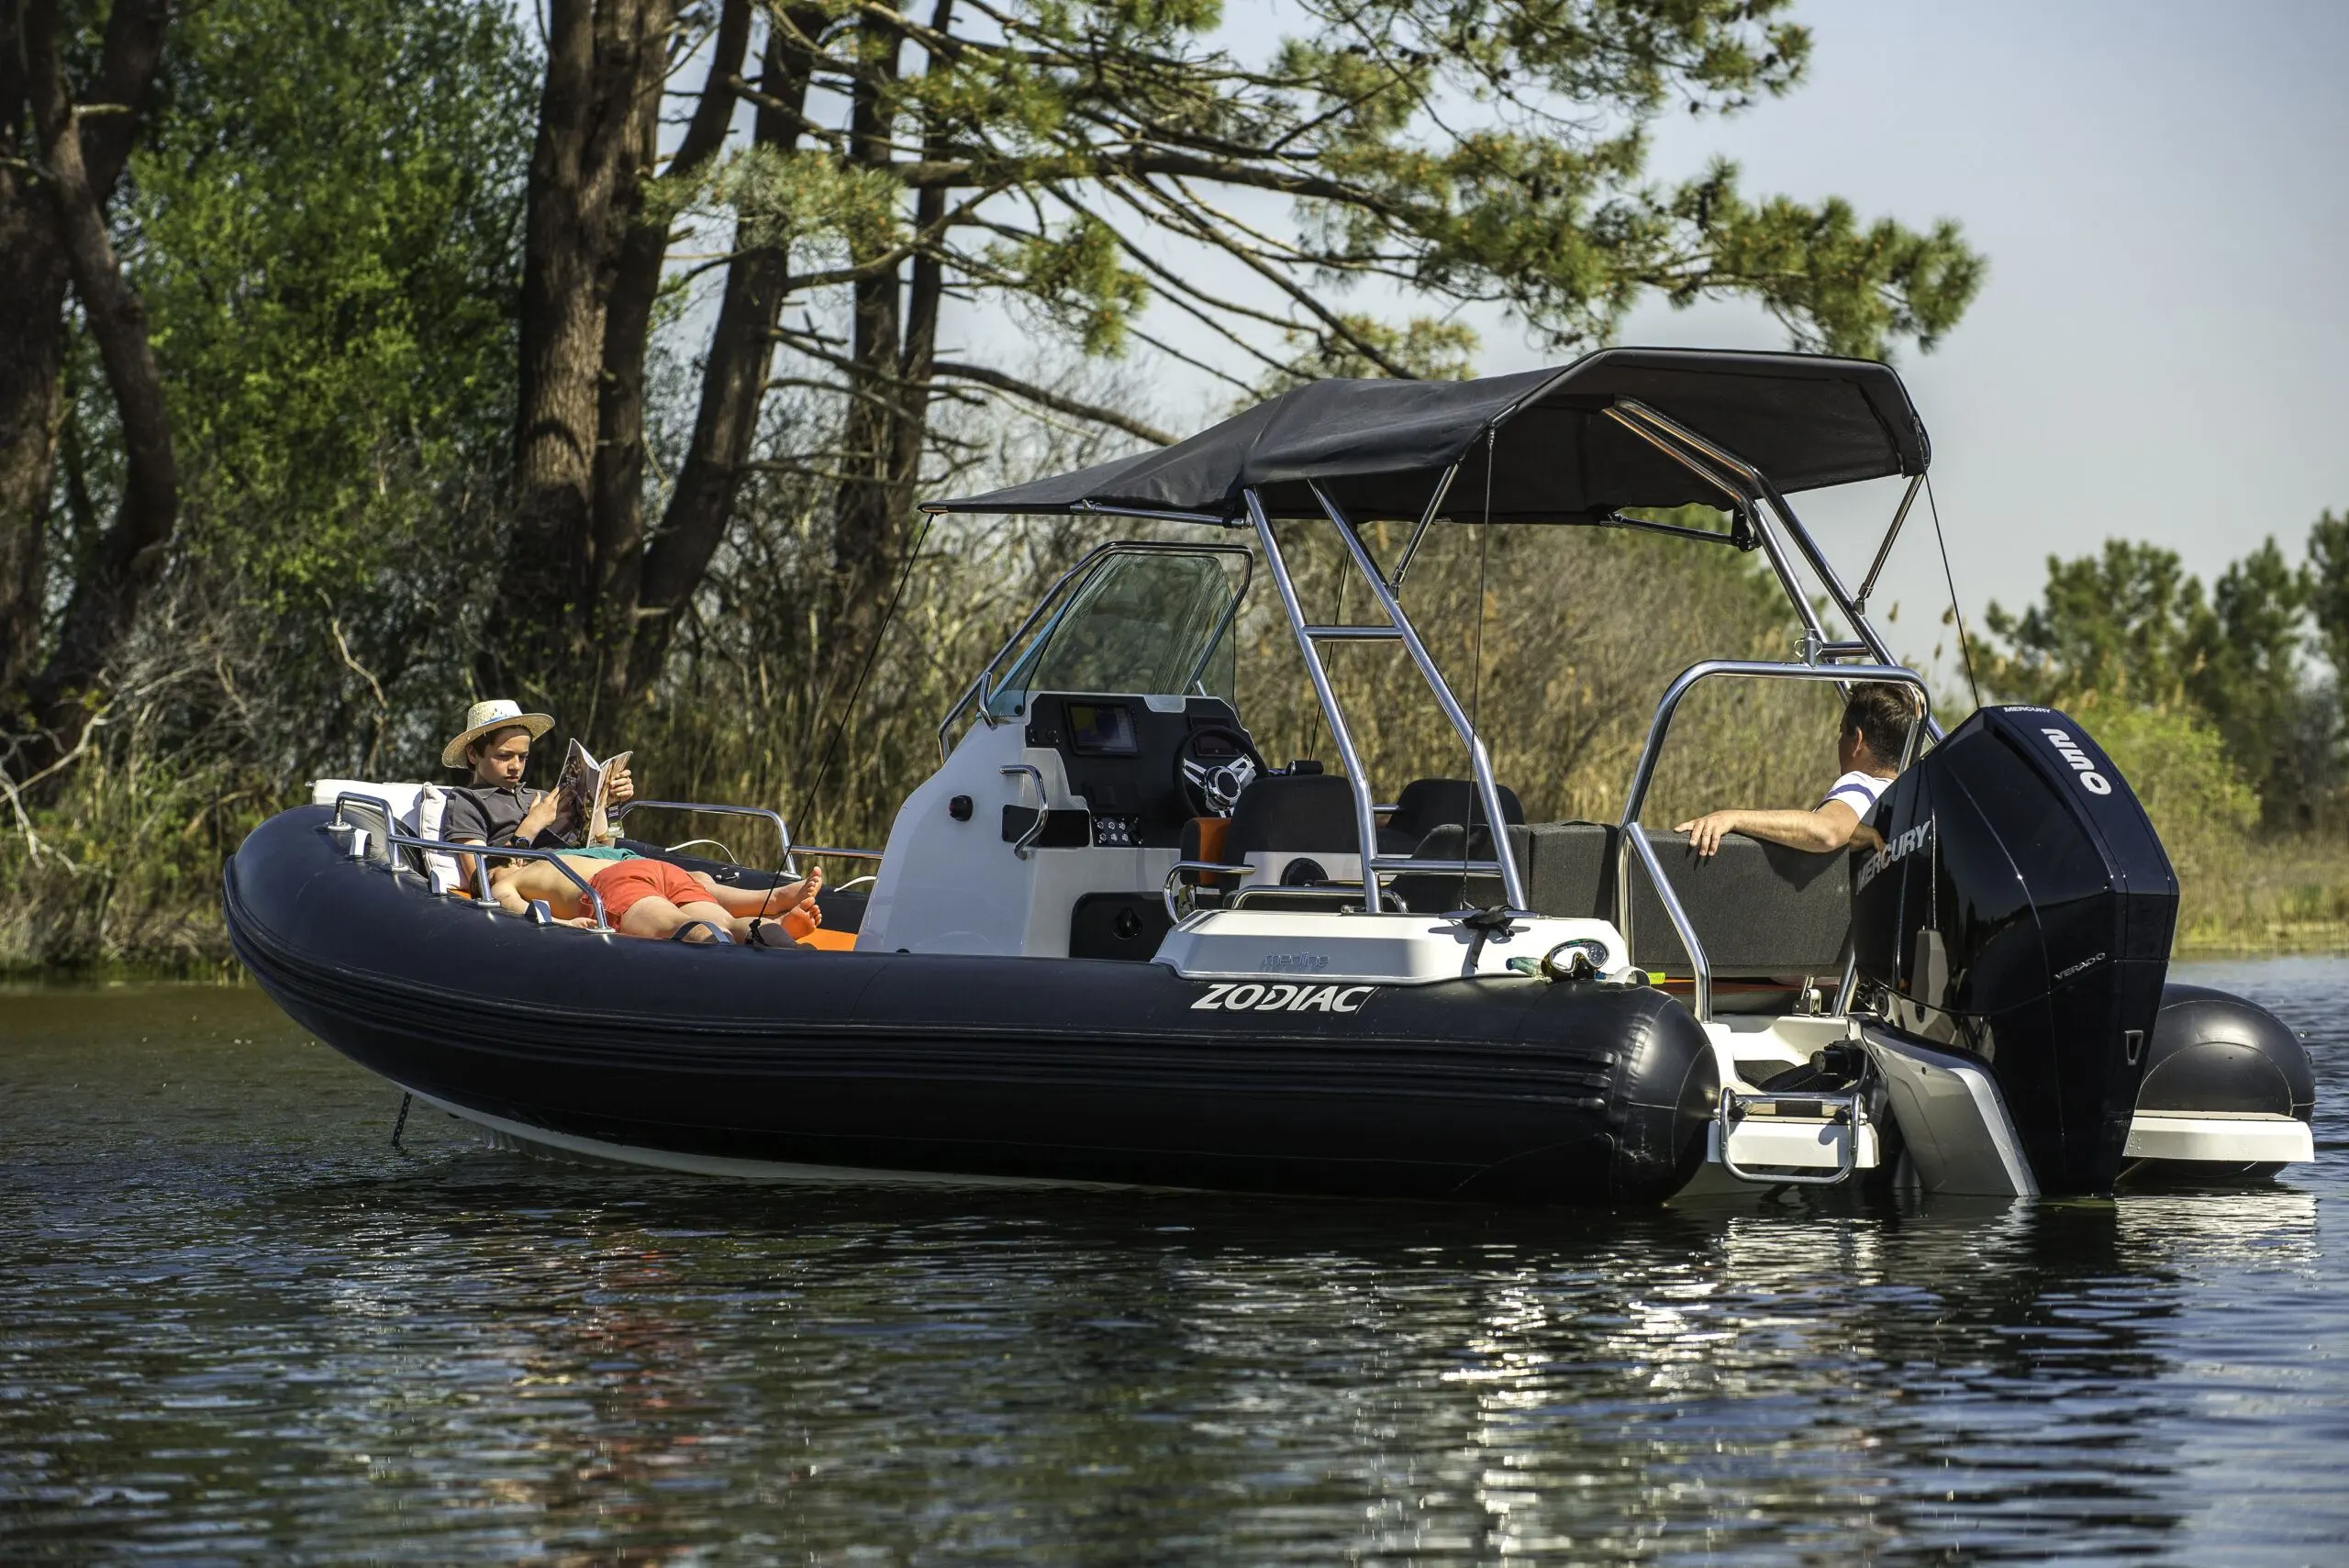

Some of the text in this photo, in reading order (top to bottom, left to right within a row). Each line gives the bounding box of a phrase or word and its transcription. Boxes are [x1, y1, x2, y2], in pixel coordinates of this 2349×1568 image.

[2003, 706, 2051, 714] MERCURY
[2040, 728, 2112, 795] 250
[1855, 820, 1932, 895] MERCURY
[1263, 951, 1330, 968] medline
[2054, 952, 2106, 980] VERADO
[1190, 984, 1380, 1015] ZODIAC
